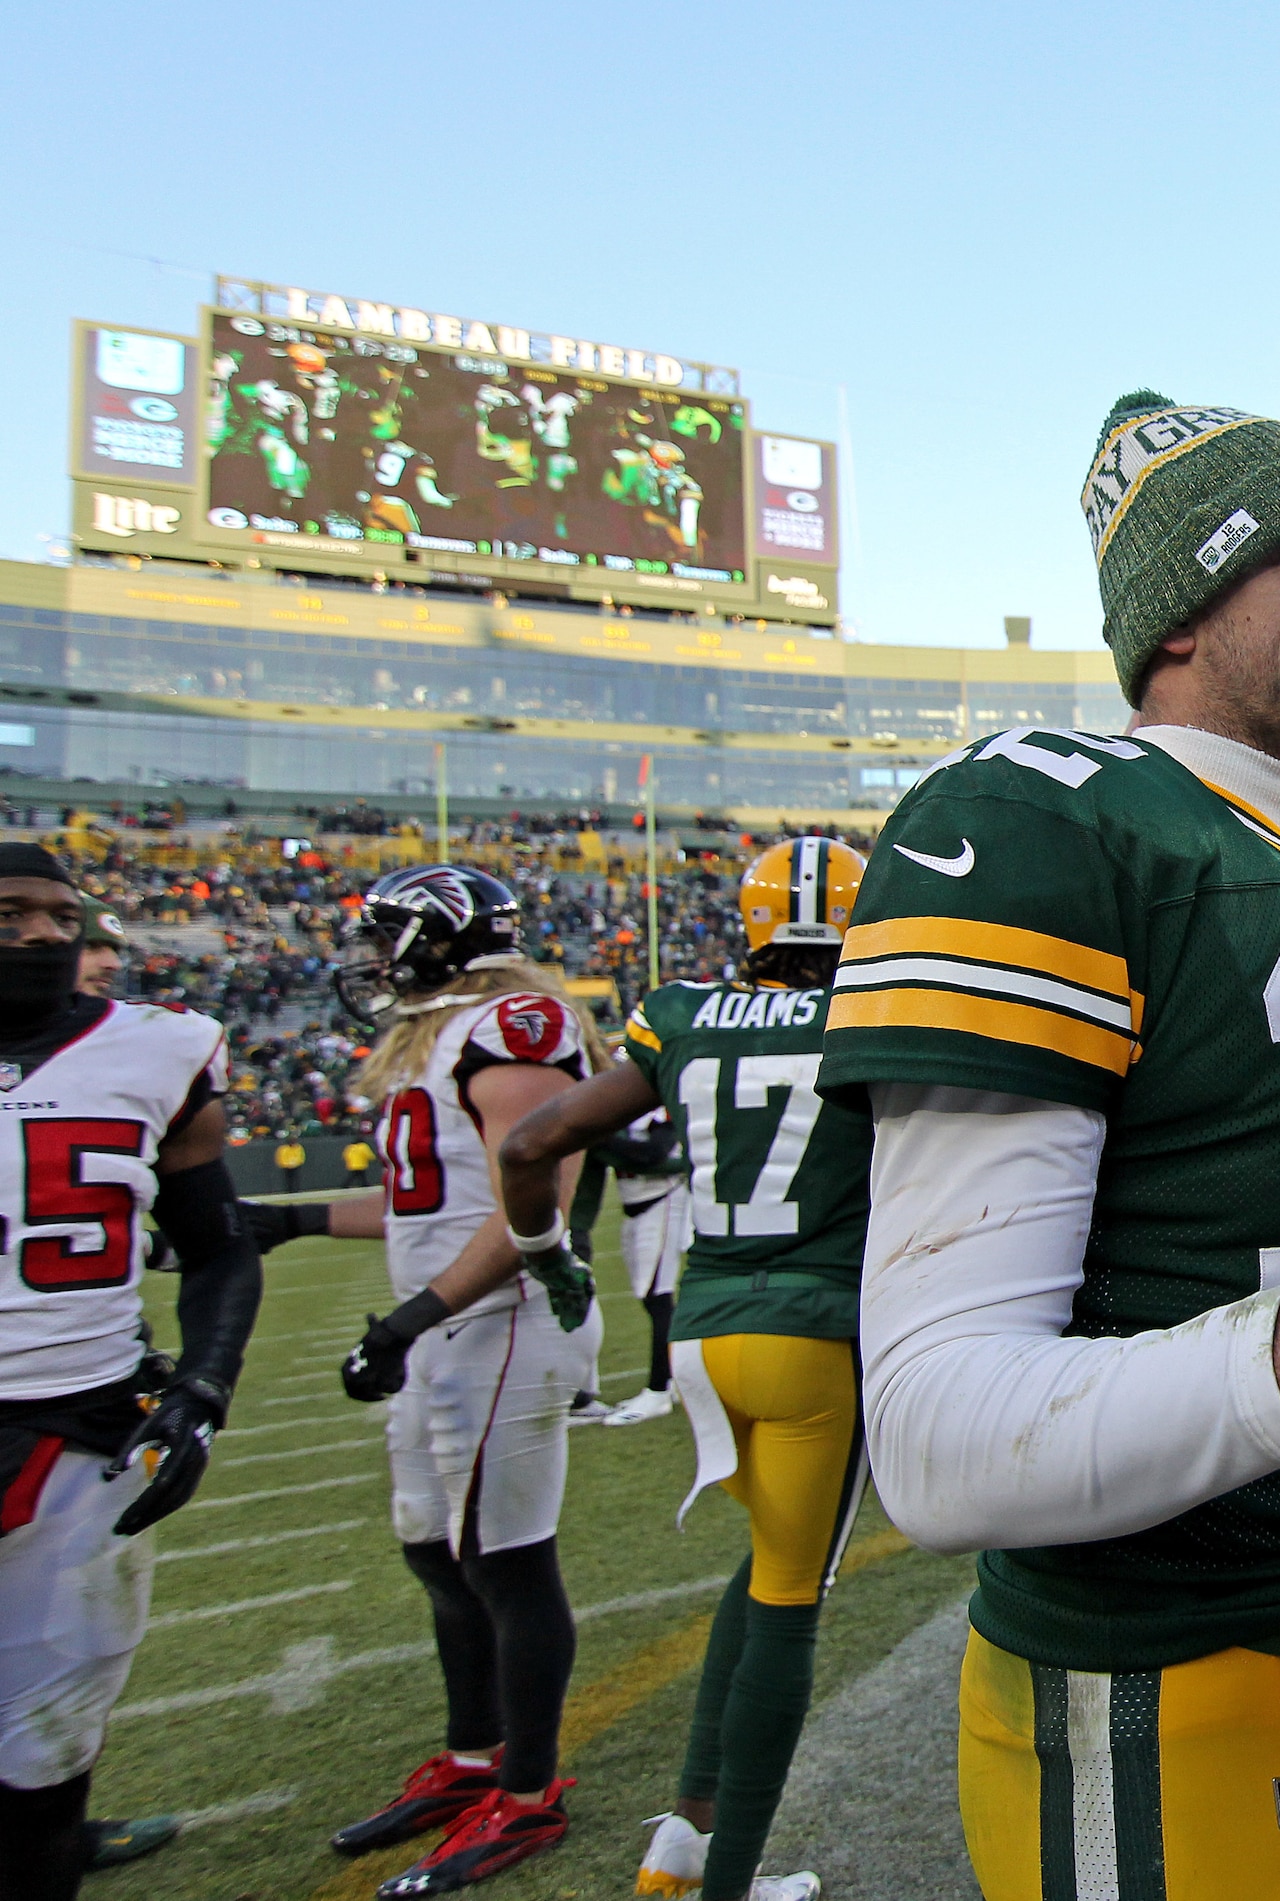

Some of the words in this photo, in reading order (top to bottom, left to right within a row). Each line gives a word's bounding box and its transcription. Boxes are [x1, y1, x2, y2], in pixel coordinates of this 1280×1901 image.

[286, 286, 532, 361] LAMBEAU
[549, 334, 684, 387] FIELD
[92, 492, 181, 537] Lite
[1221, 523, 1236, 538] 12
[1220, 523, 1252, 555] RODGERS
[692, 989, 825, 1029] ADAMS
[679, 1053, 823, 1237] 17
